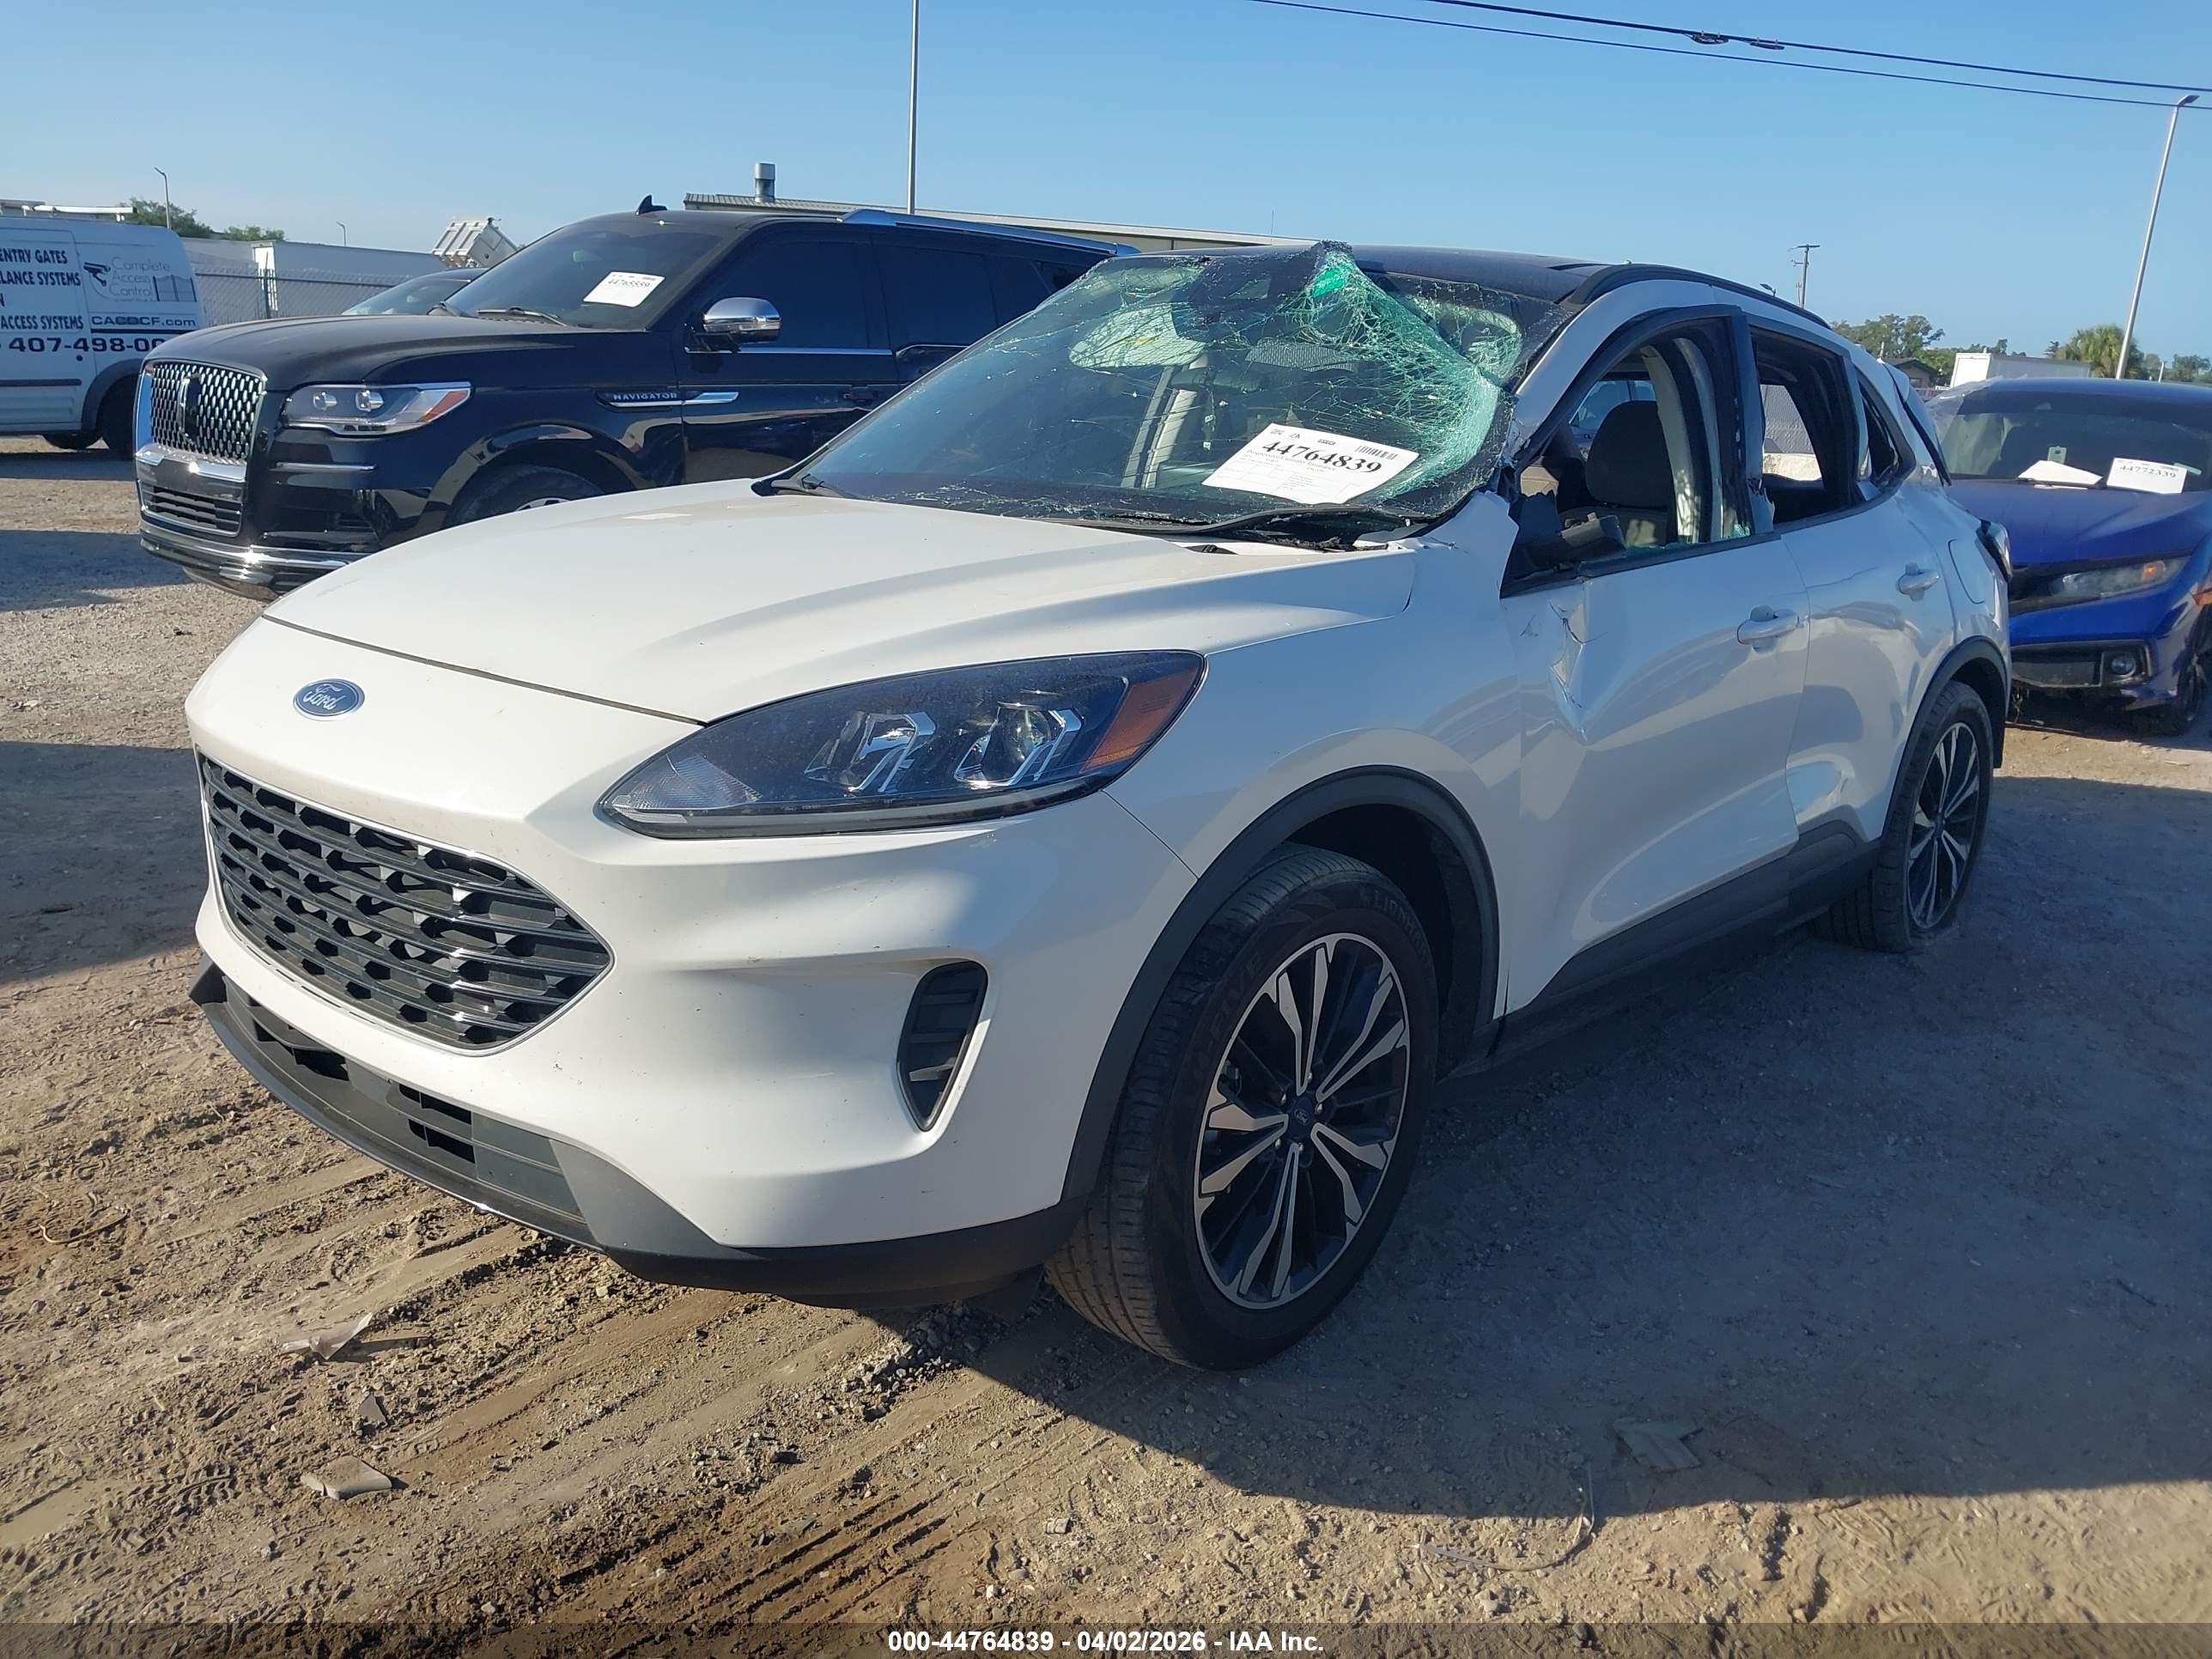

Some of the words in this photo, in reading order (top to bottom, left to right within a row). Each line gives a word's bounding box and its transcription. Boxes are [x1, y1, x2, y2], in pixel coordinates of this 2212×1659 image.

[35, 250, 68, 264] GATES
[112, 256, 170, 274] Complete
[0, 270, 35, 285] LANCE
[37, 271, 82, 286] SYSTEMS
[112, 269, 151, 283] Access
[108, 283, 154, 297] Control
[1, 315, 38, 330] ACCESS
[40, 315, 84, 330] SYSTEMS
[613, 392, 678, 401] NAVIGATOR
[1261, 441, 1383, 473] 44764839
[302, 684, 347, 710] Ford
